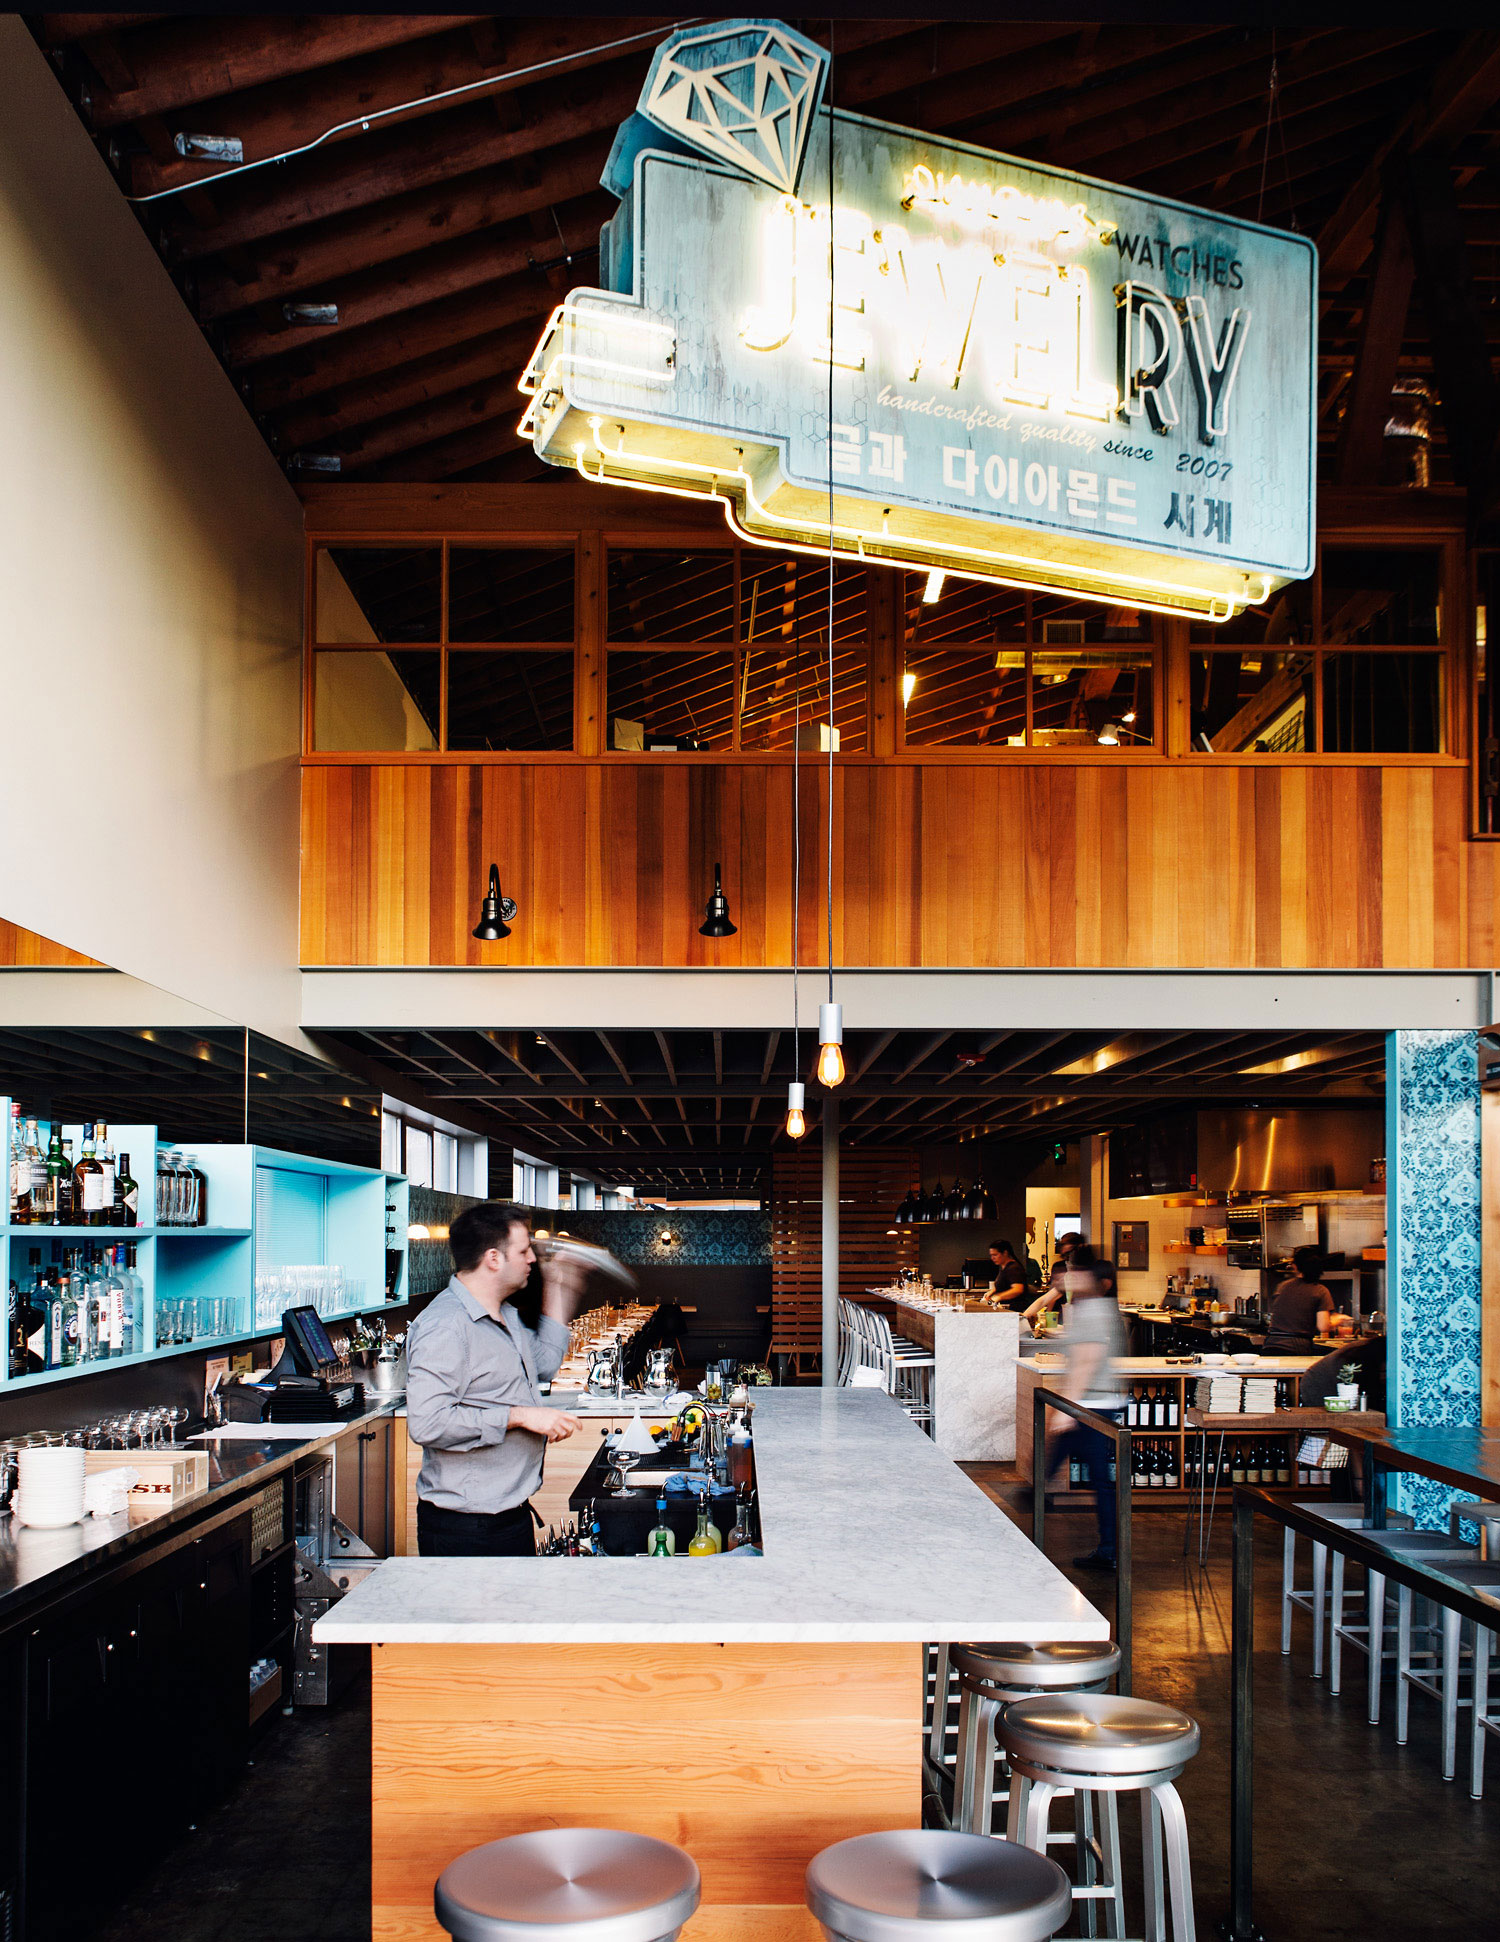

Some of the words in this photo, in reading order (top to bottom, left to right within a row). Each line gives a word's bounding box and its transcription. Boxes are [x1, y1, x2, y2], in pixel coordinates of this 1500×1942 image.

[1115, 230, 1244, 290] WATCHES
[738, 197, 1251, 447] JEWELRY
[876, 384, 1012, 432] handcrafted
[1019, 418, 1098, 455] quality
[1103, 438, 1155, 463] since
[1175, 452, 1234, 483] 2007
[943, 445, 1138, 526] 다이아몬드
[1163, 491, 1233, 546] 시계
